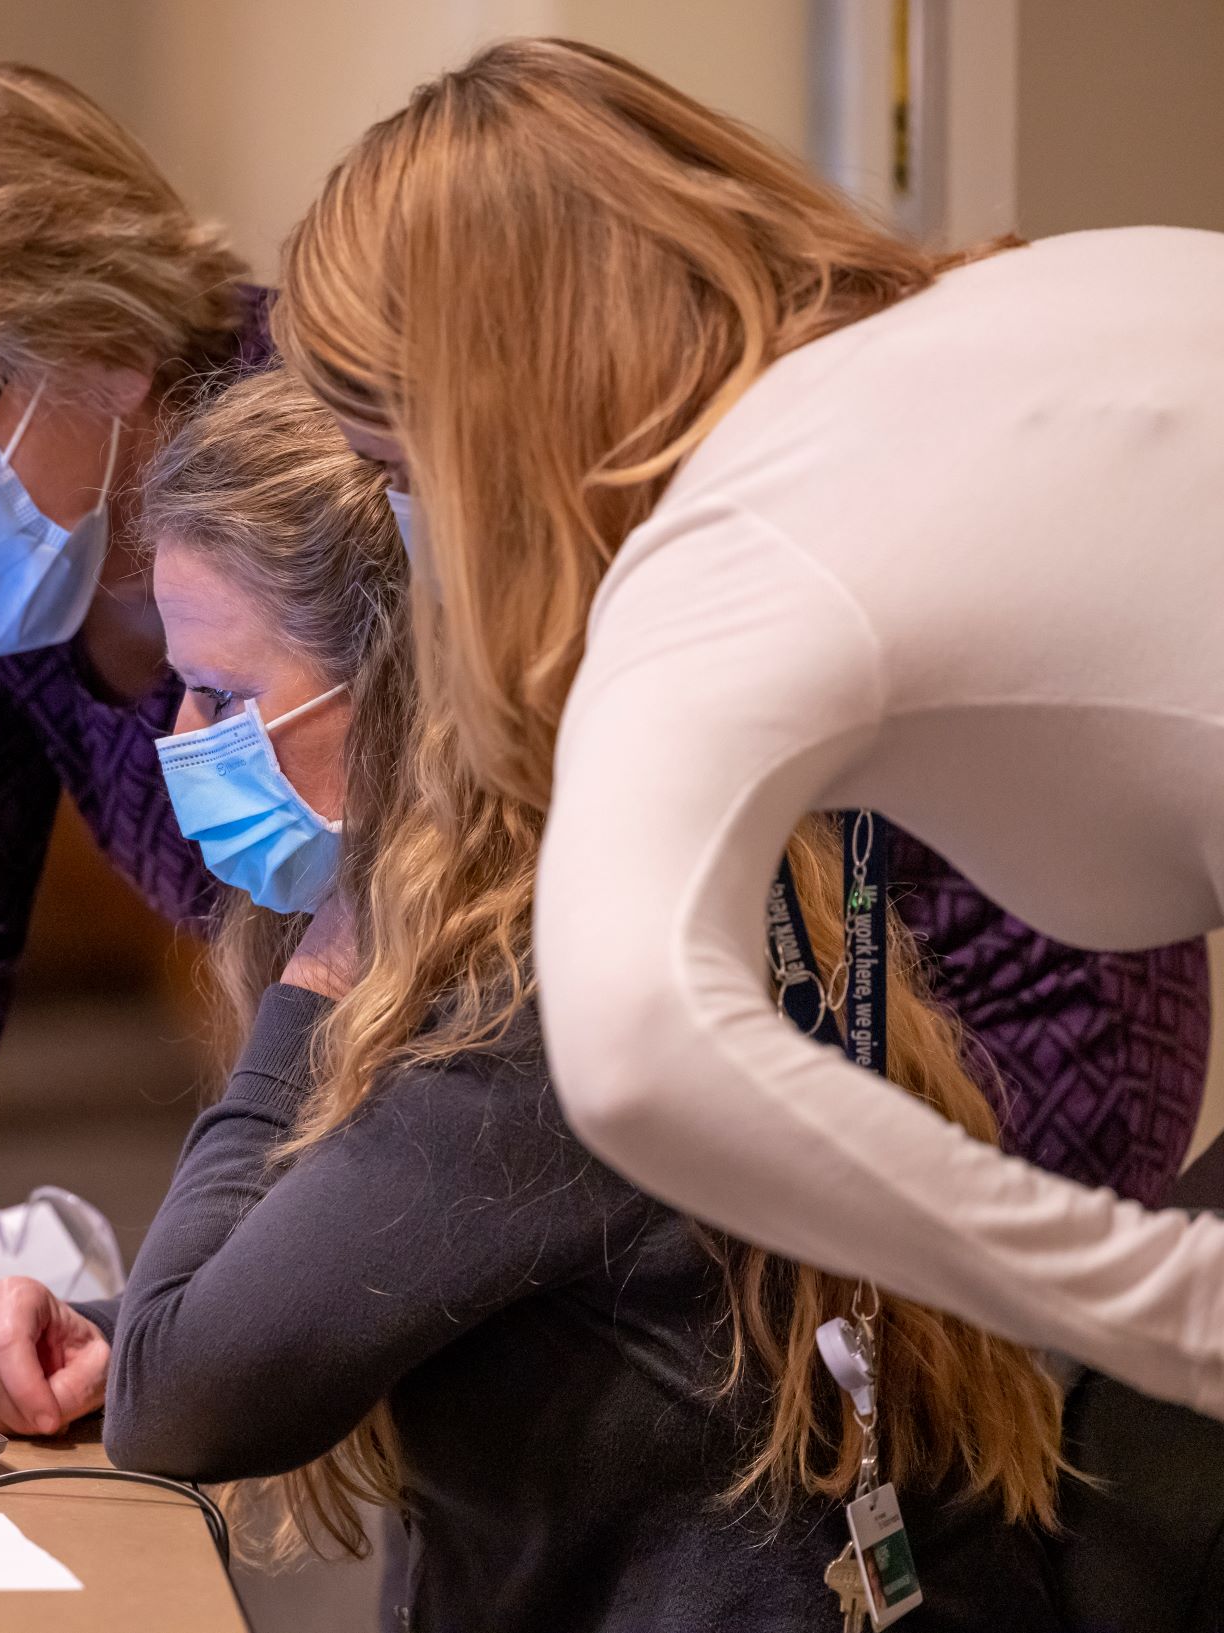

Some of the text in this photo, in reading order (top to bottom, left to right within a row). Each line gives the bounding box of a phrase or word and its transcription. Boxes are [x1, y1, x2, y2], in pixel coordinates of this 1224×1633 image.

[856, 913, 879, 956] work
[852, 958, 879, 1000] here,
[856, 1002, 872, 1028] we
[850, 1029, 879, 1067] give
